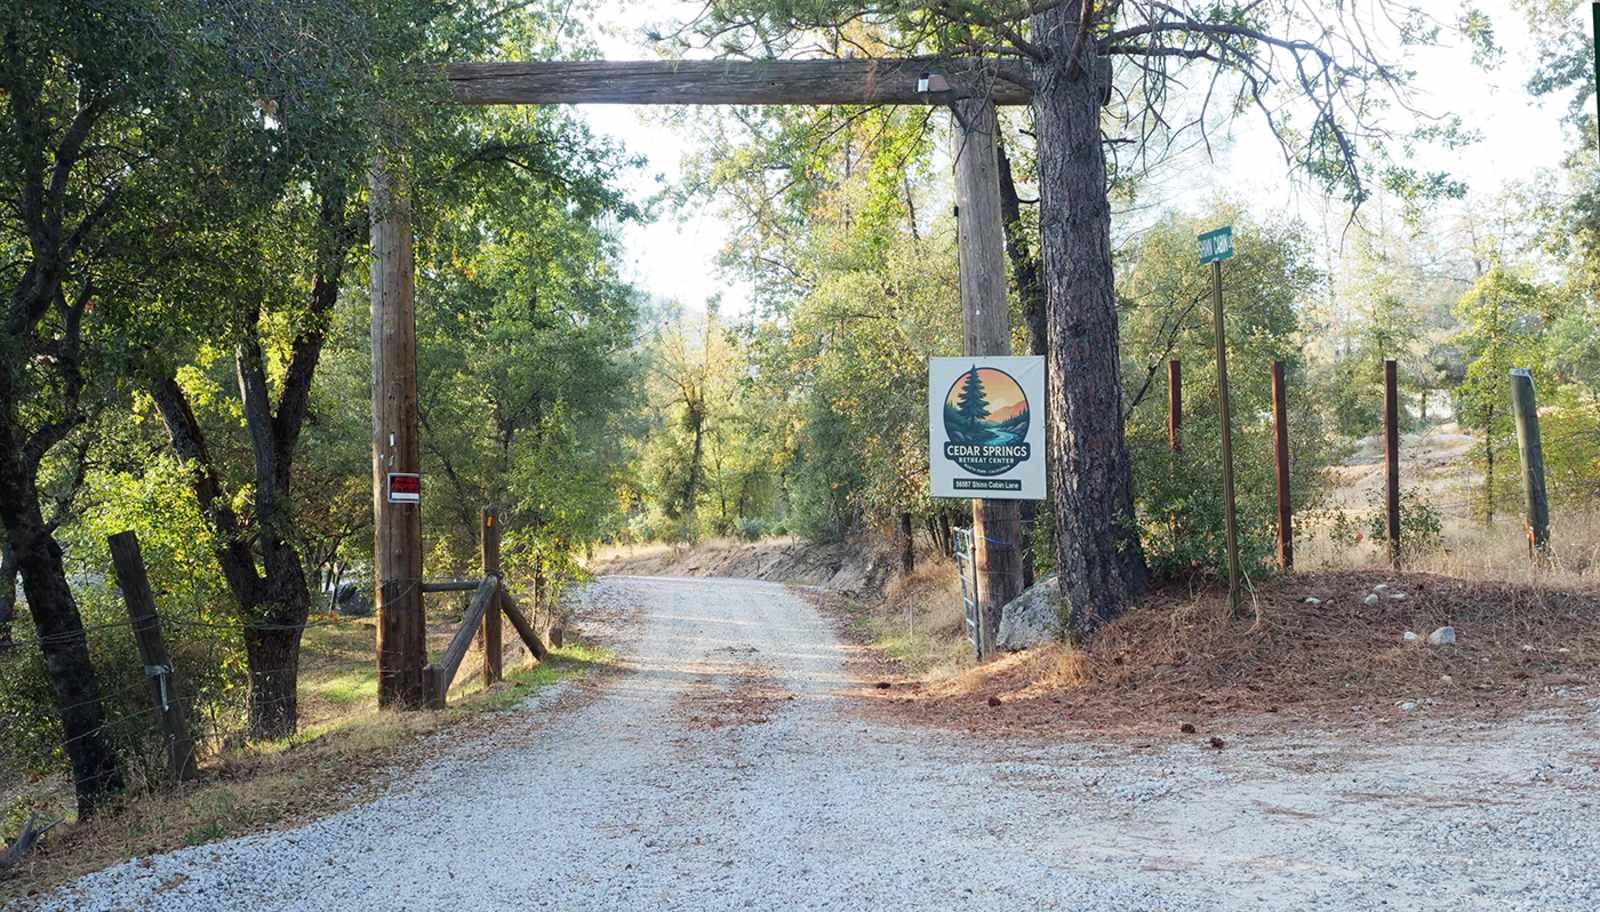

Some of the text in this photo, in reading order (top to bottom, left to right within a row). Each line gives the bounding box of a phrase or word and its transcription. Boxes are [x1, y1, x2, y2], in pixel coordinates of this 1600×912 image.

[947, 445, 1027, 457] CEDAR SPRINGS
[988, 481, 1004, 489] Cabin
